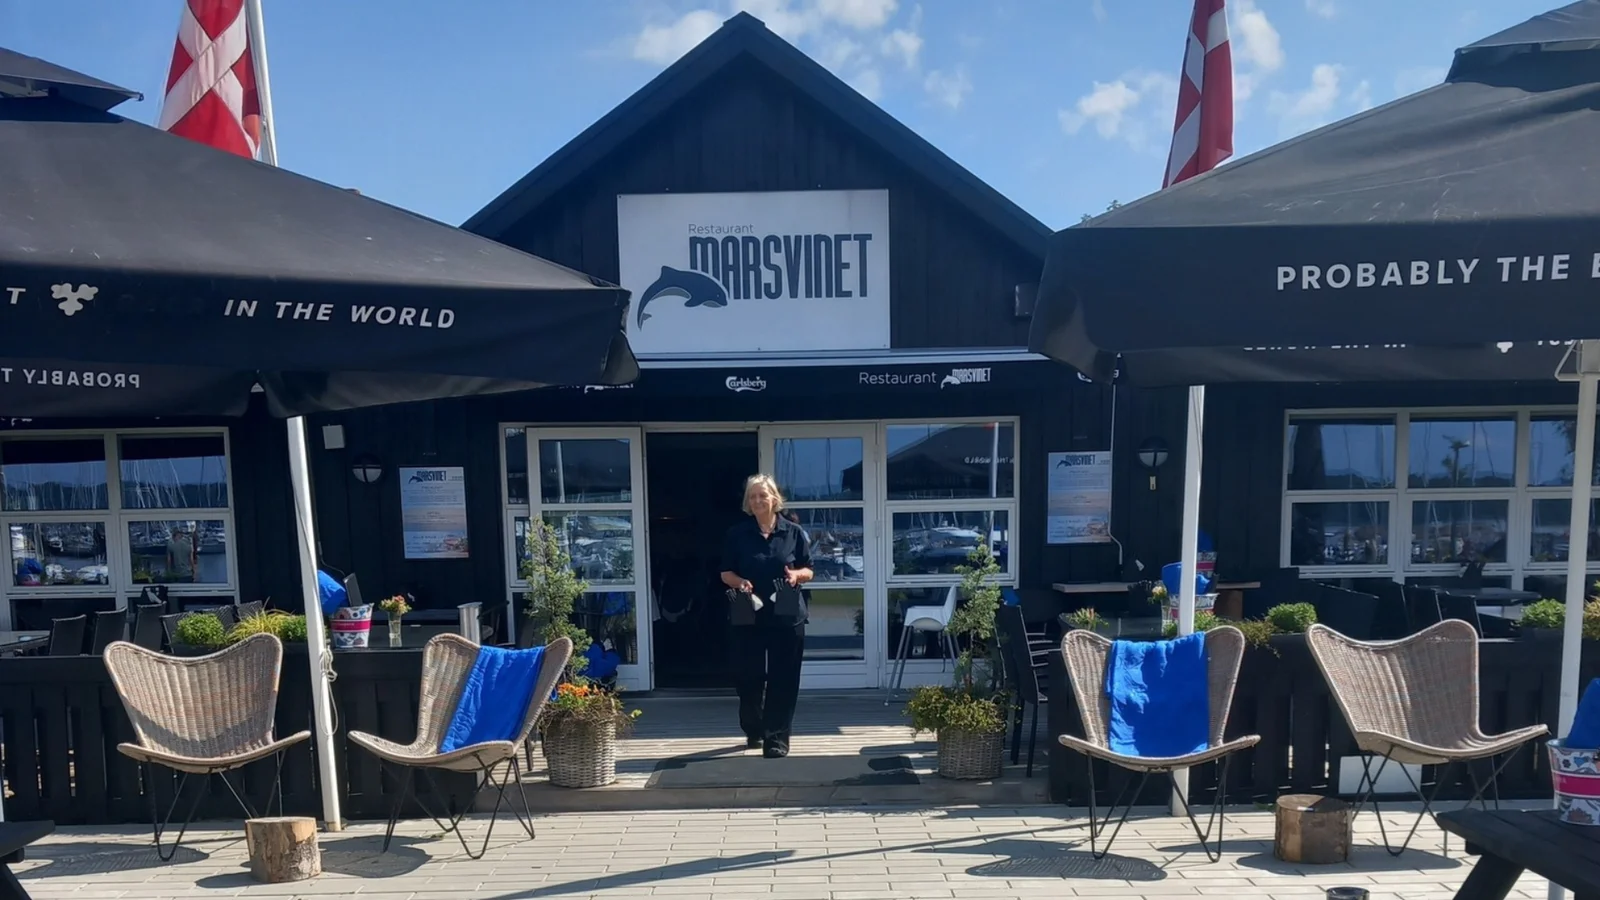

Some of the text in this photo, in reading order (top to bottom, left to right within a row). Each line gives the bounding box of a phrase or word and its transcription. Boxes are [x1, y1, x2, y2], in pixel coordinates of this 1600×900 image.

[688, 223, 754, 234] Restaurant
[689, 233, 873, 300] MARSVINET
[1276, 258, 1480, 290] PROBABLY
[1497, 253, 1570, 282] THE
[224, 299, 455, 329] IN THE WORLD
[725, 376, 767, 392] Carlsberg
[859, 371, 937, 385] Restaurant
